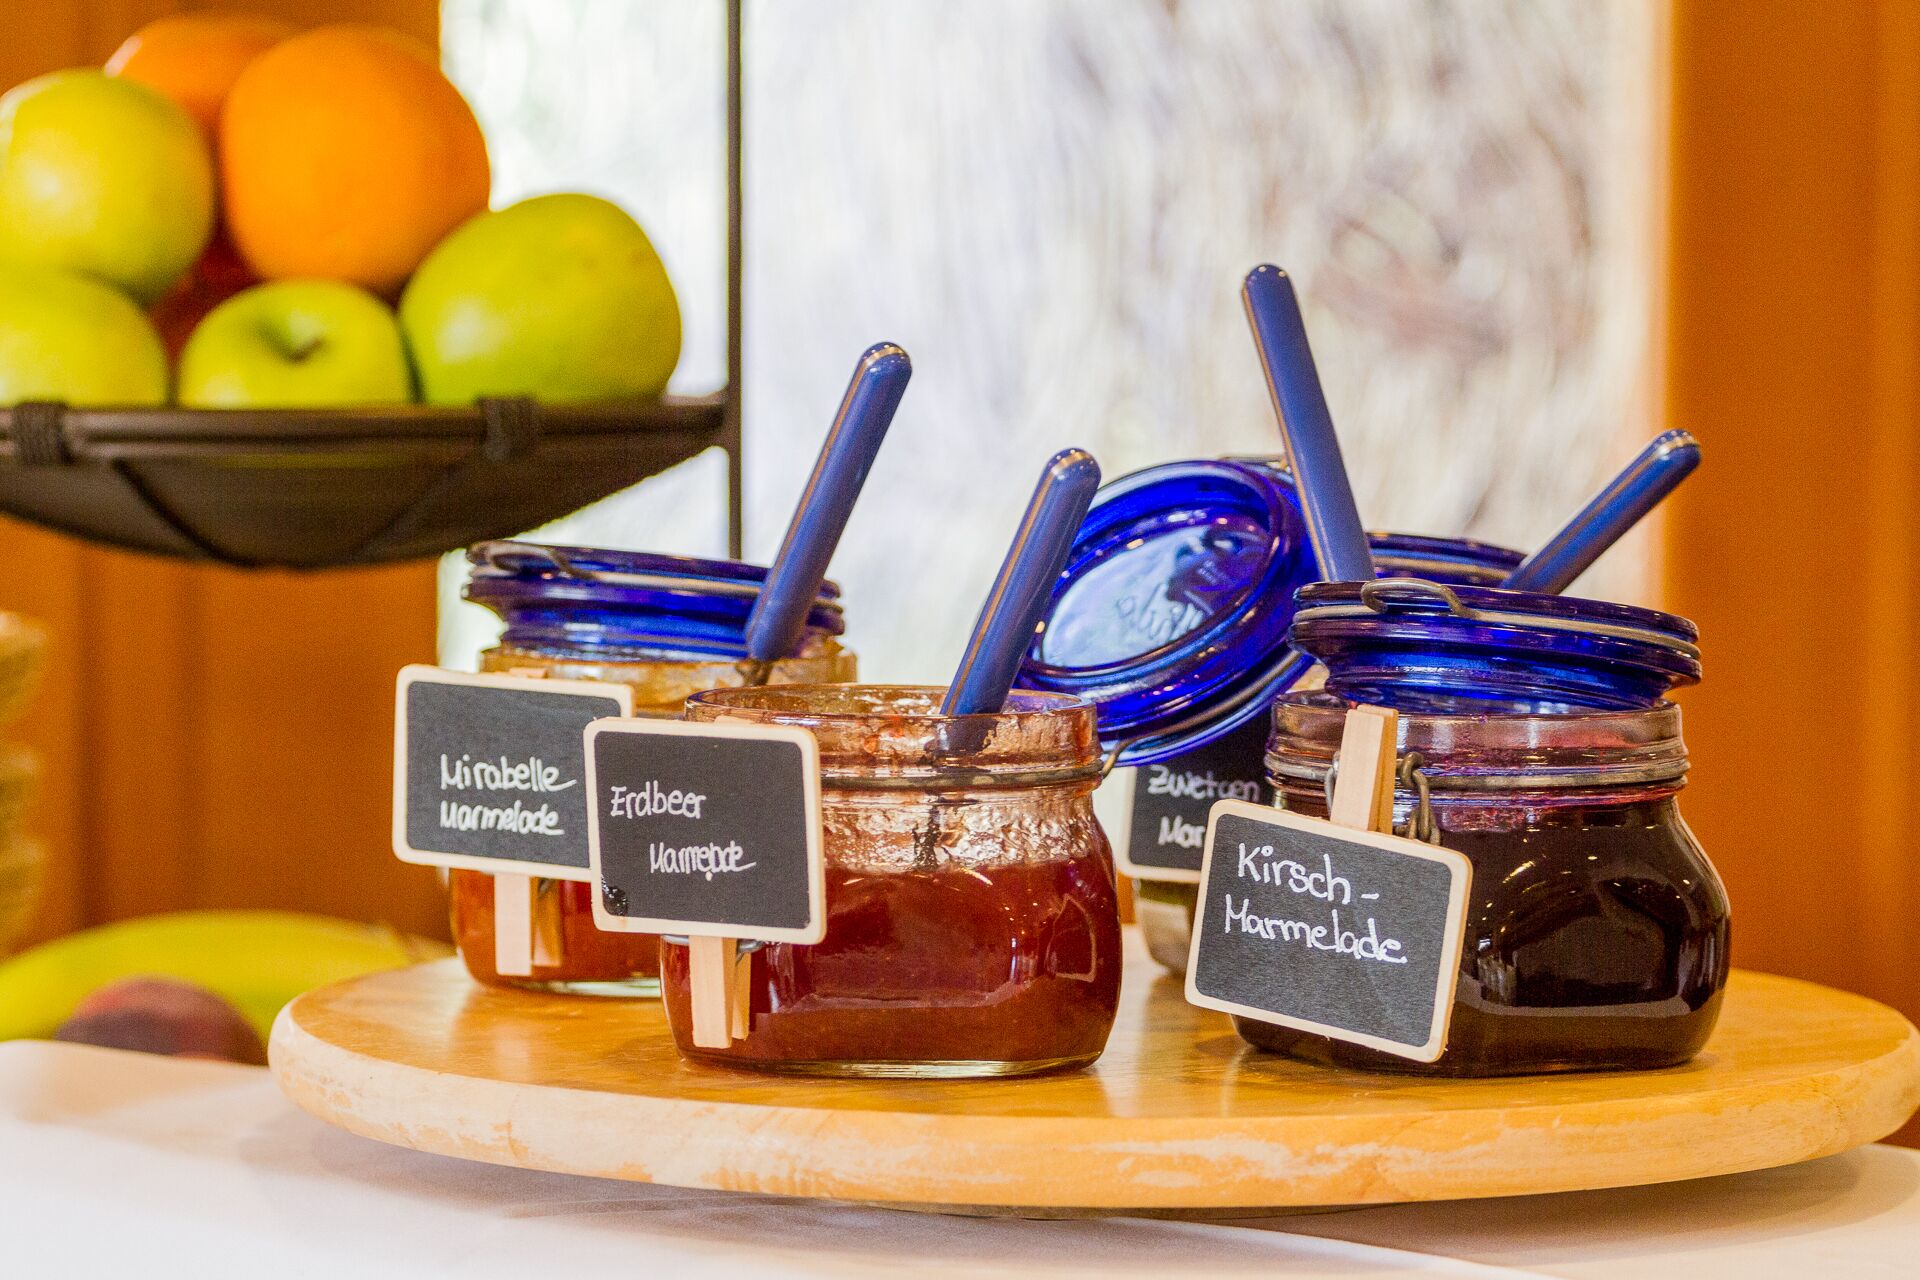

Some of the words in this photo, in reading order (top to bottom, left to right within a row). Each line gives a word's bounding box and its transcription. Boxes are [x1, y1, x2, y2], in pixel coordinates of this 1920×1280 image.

[440, 753, 578, 793] Mirabelle
[440, 800, 565, 836] Marmelade
[610, 780, 707, 820] Erdbeer
[1224, 893, 1408, 964] Marmelade
